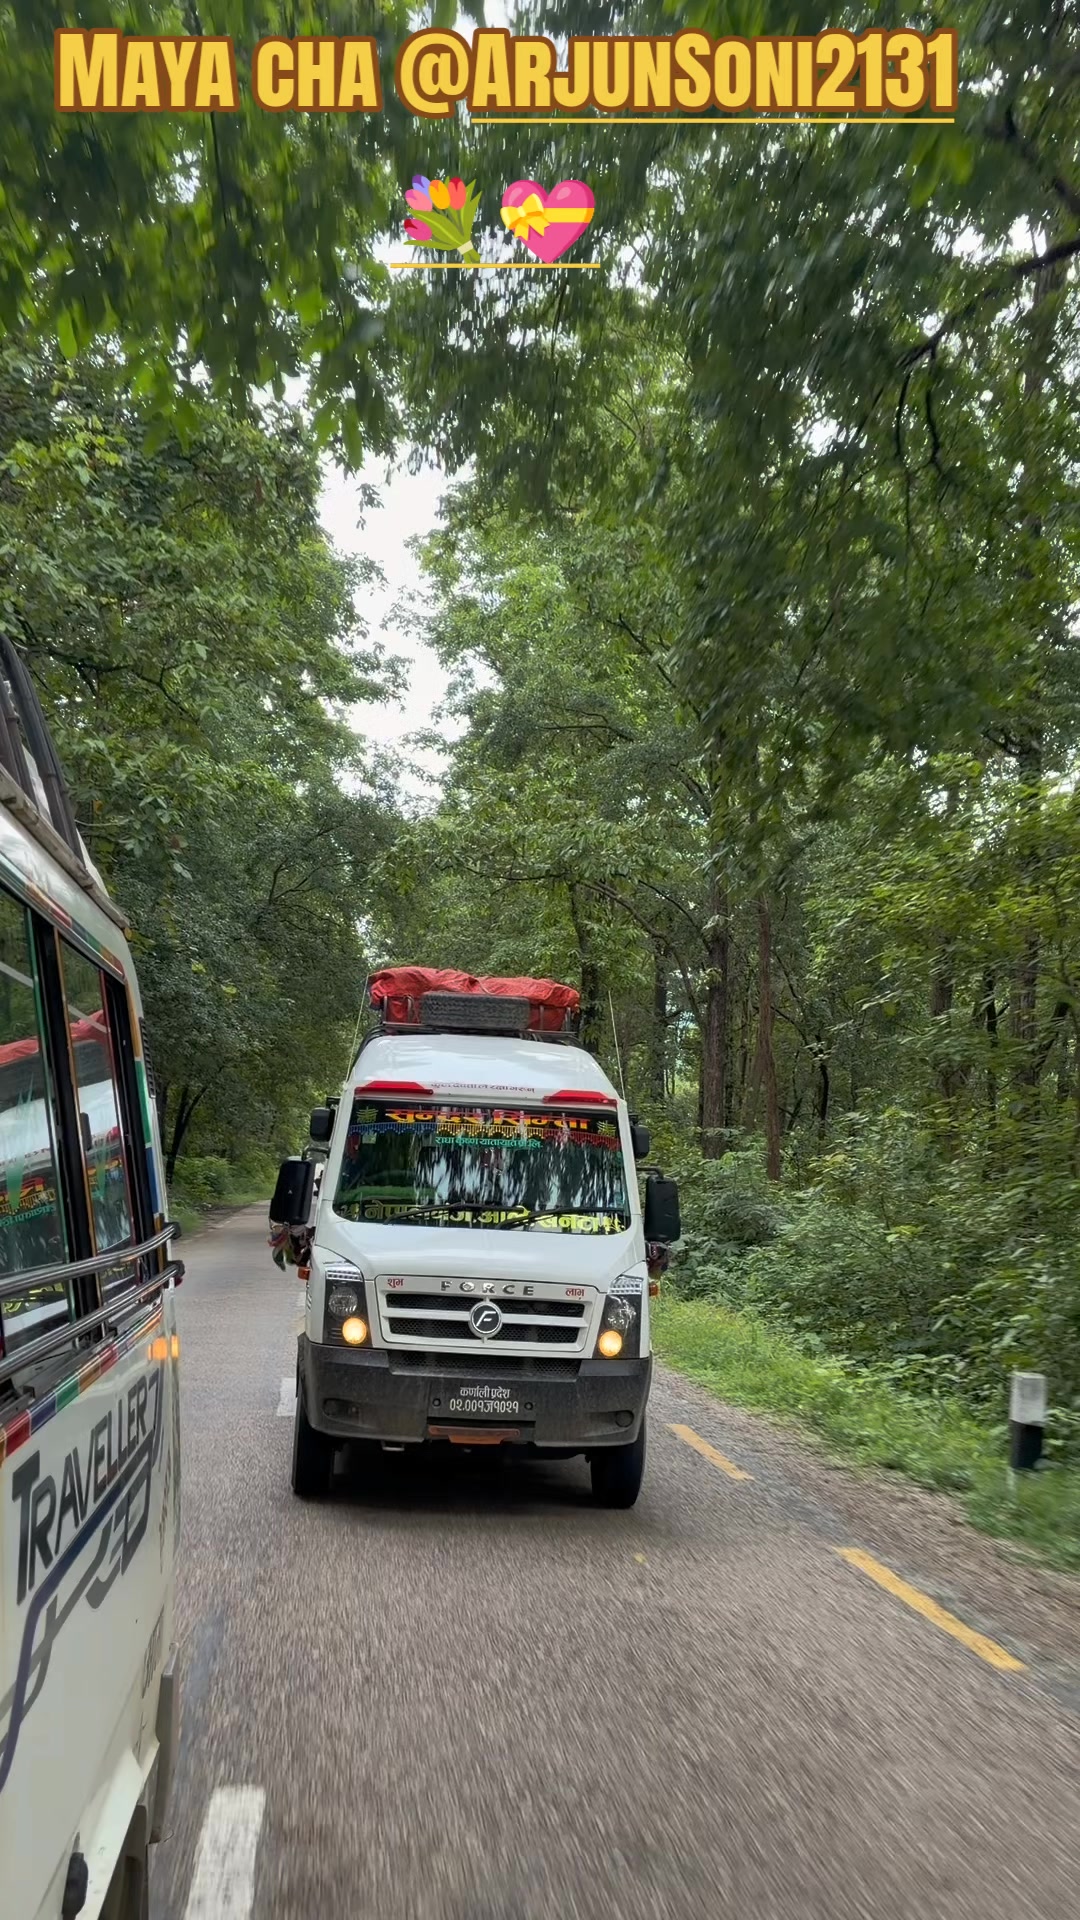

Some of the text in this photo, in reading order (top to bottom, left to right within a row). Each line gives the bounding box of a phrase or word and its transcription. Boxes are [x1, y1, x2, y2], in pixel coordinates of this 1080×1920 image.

[387, 1278, 404, 1289] शुभ
[440, 1281, 534, 1296] FORCE
[565, 1287, 585, 1298] लाभ
[460, 1385, 511, 1400] कर्णाली प्रदेश
[11, 1374, 148, 1607] TRAVELLER
